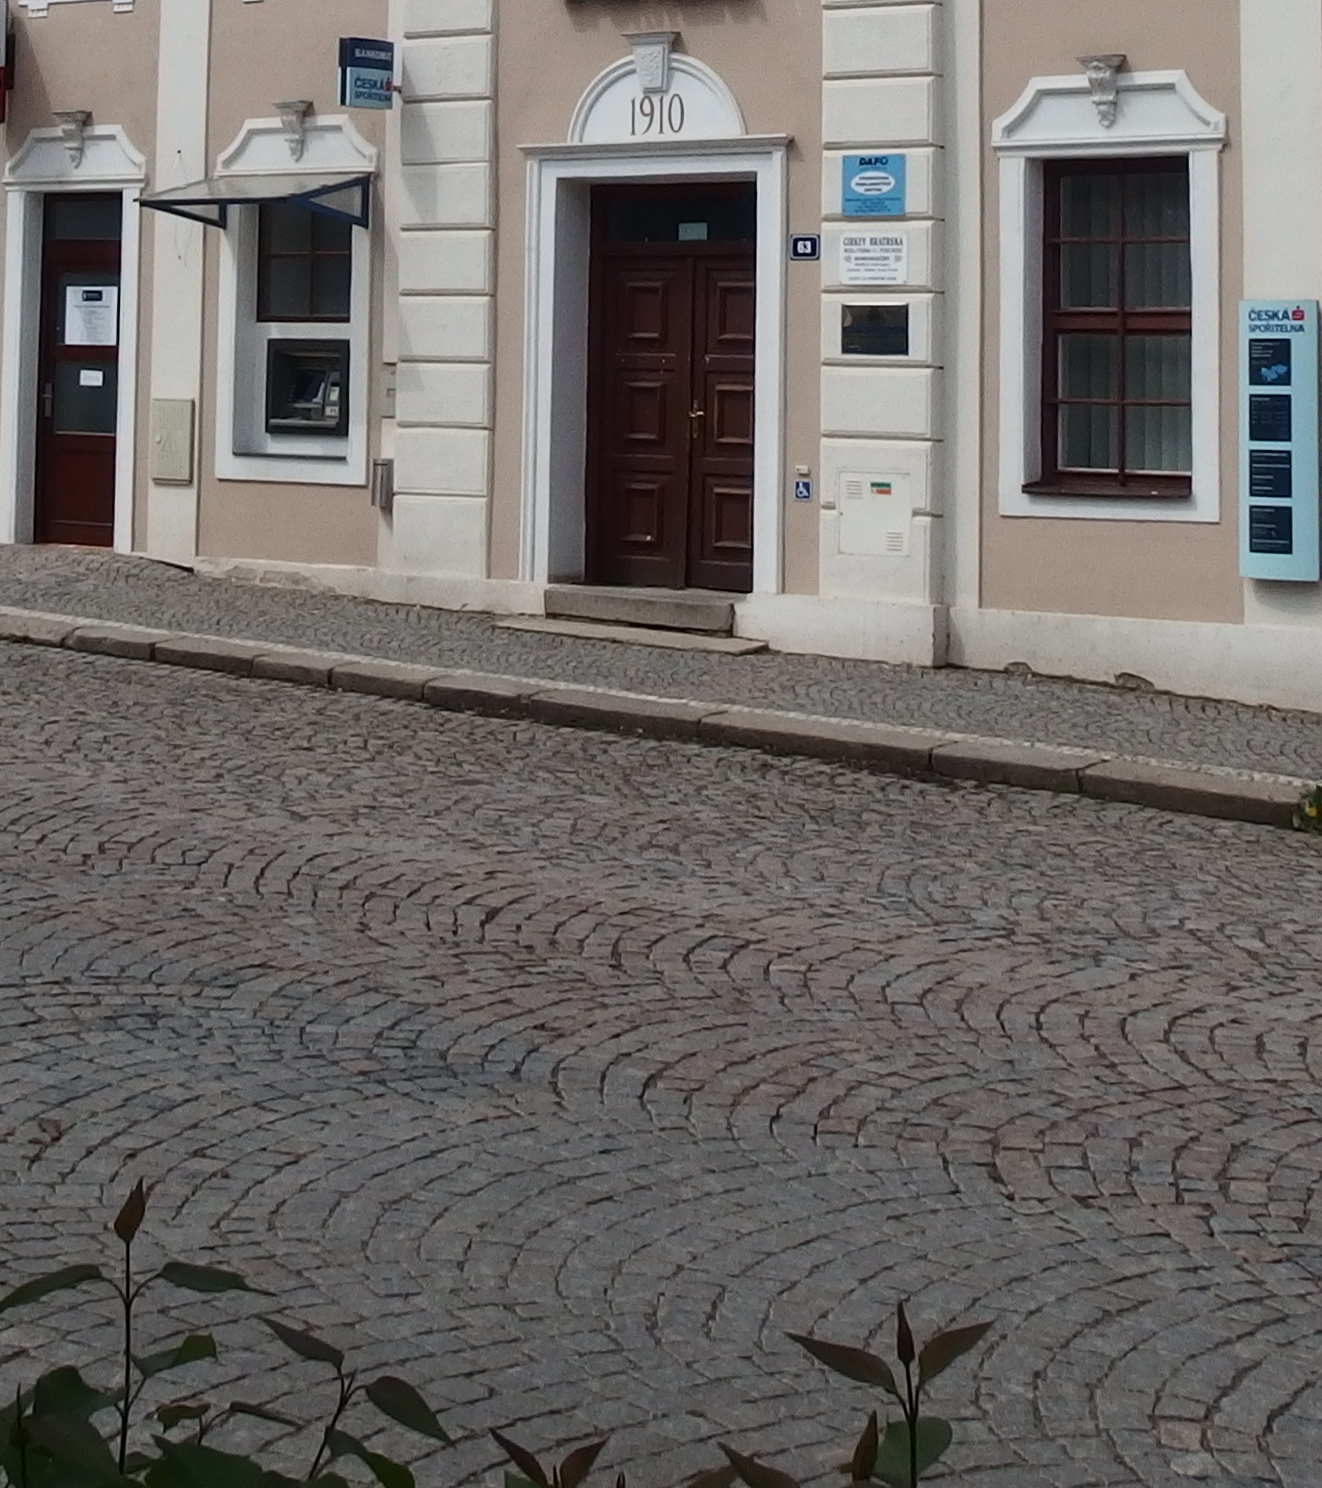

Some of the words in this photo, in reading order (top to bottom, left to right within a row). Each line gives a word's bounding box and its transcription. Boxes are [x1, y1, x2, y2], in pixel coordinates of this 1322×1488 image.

[630, 93, 684, 136] 1910
[1248, 308, 1290, 321] ČESKÁ
[1249, 322, 1305, 333] SPOŘITELNA
